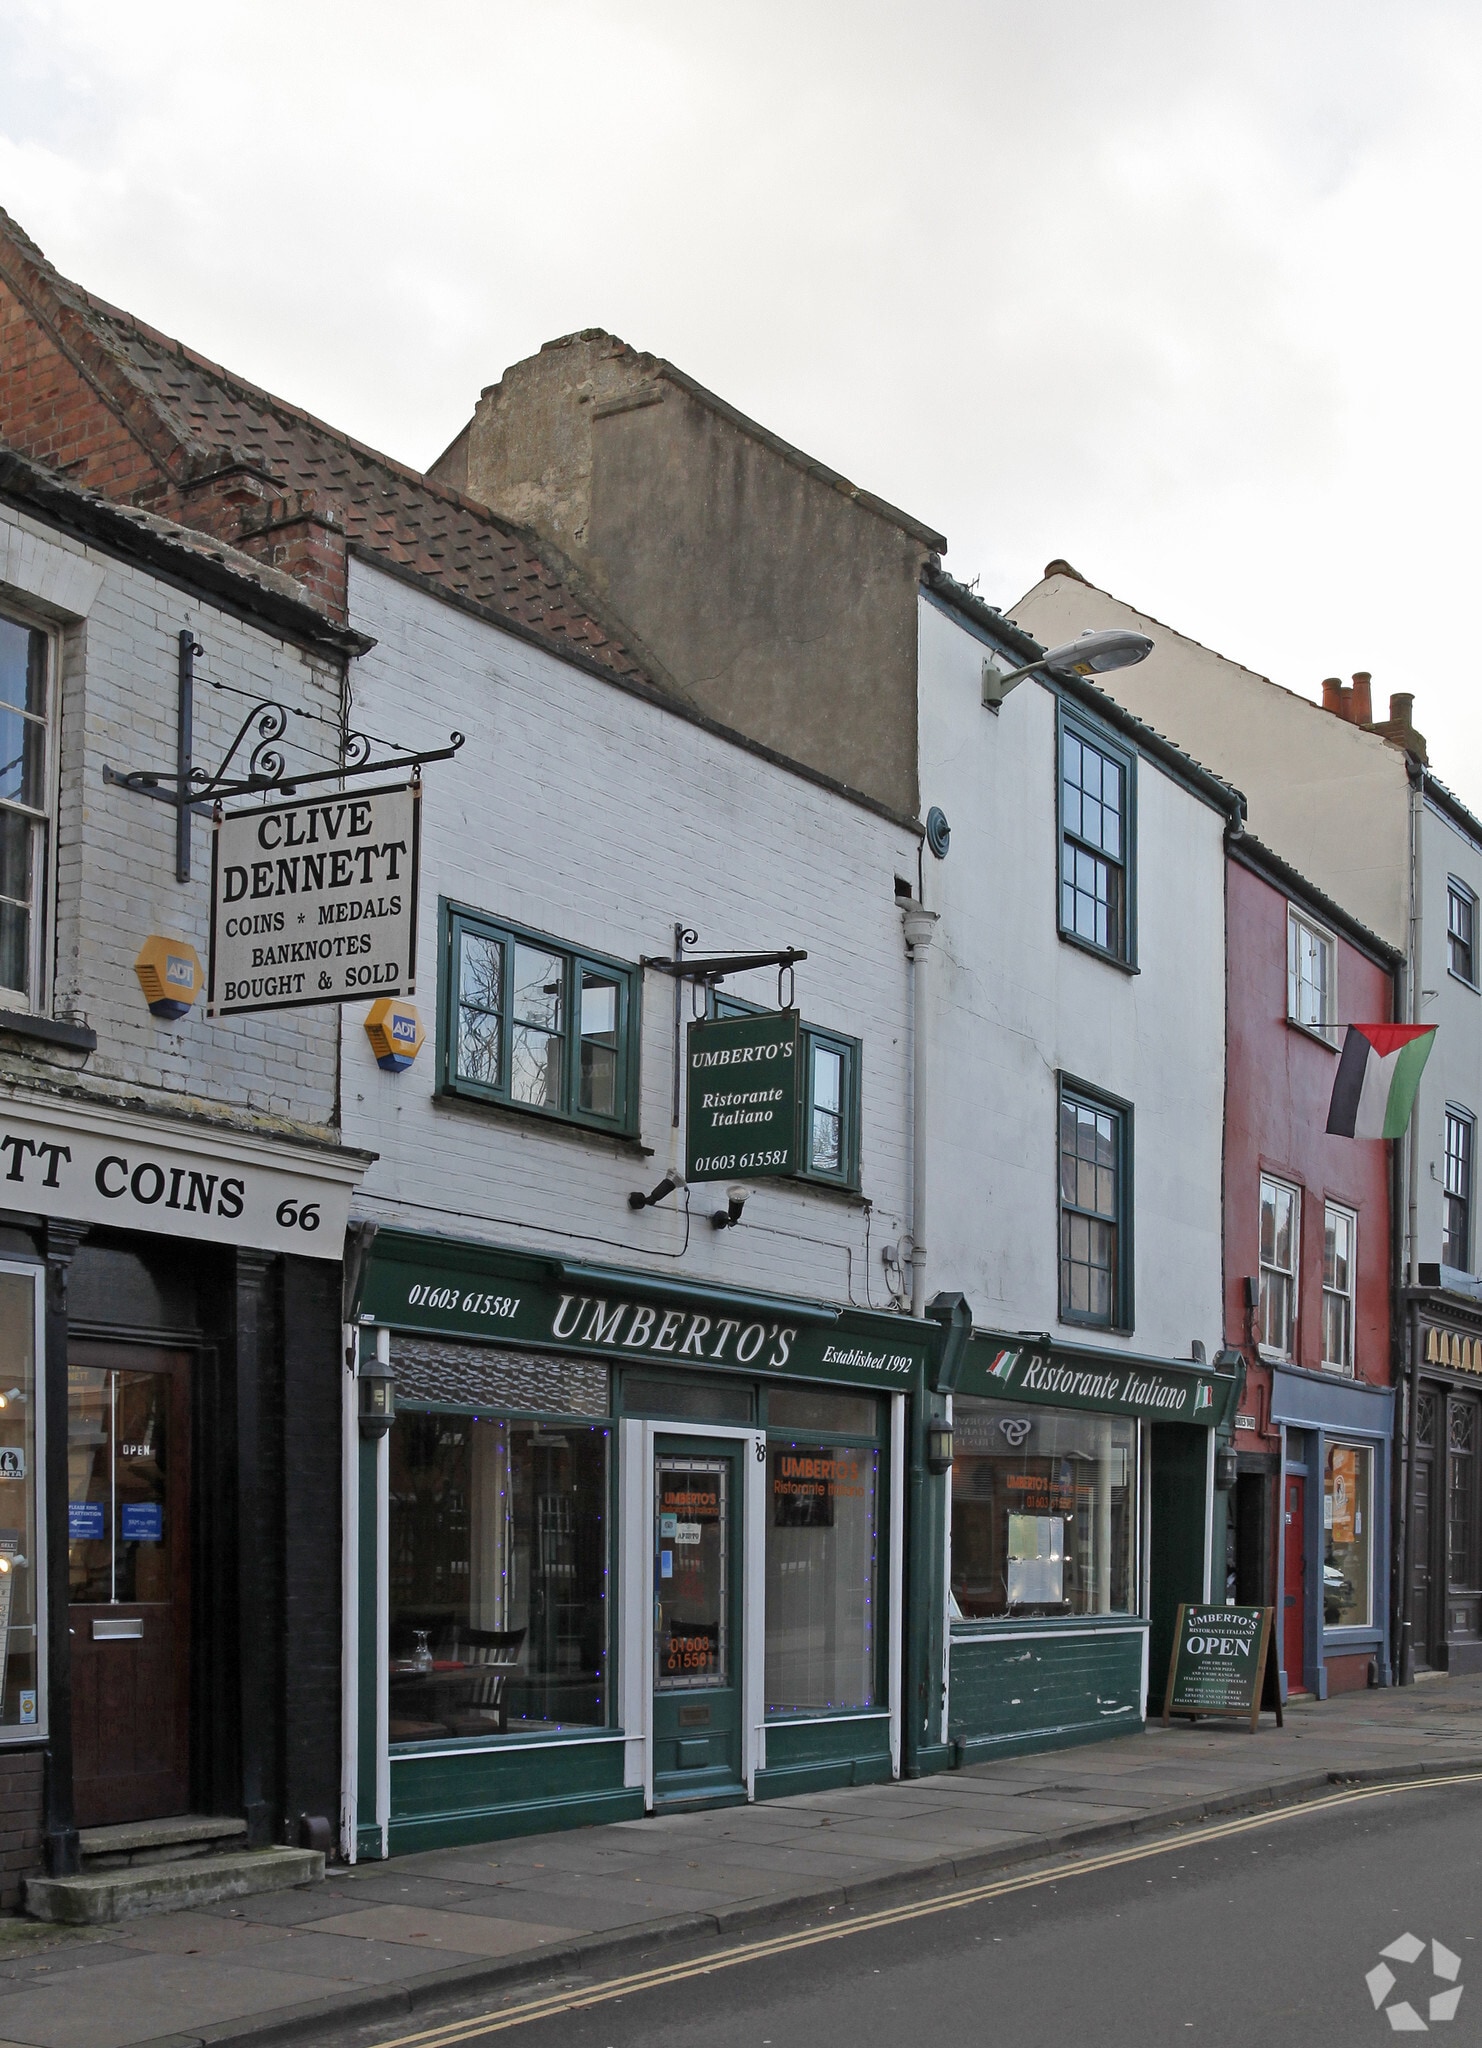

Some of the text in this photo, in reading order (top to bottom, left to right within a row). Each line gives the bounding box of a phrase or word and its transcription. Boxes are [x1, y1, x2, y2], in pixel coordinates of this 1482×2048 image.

[258, 801, 373, 849] CLIVE
[223, 841, 407, 903] DENNETT
[226, 896, 401, 937] COINS MEDALS
[252, 934, 371, 967] BANKNOTES
[168, 960, 193, 981] ADT
[225, 962, 399, 1000] BOUGHT & SOLD
[393, 1021, 416, 1042] ADT
[692, 1041, 794, 1068] UMBERTO'S
[702, 1088, 783, 1108] Ristorante
[711, 1110, 773, 1127] Italiano
[695, 1150, 788, 1172] 01603 615581
[95, 1156, 245, 1218] COINS
[276, 1199, 321, 1231] 66
[408, 1284, 521, 1318] 01603 615581
[552, 1294, 797, 1368] UMBERTO'S
[822, 1346, 913, 1374] Established 1992
[1021, 1355, 1187, 1410] Ristorante Italiano
[123, 1444, 150, 1455] OPEN
[774, 1480, 825, 1495] Ristorante
[1188, 1613, 1258, 1630] UMBERTO'S
[670, 1636, 709, 1653] 01603
[1186, 1636, 1252, 1656] OPEN
[667, 1651, 713, 1669] 615581
